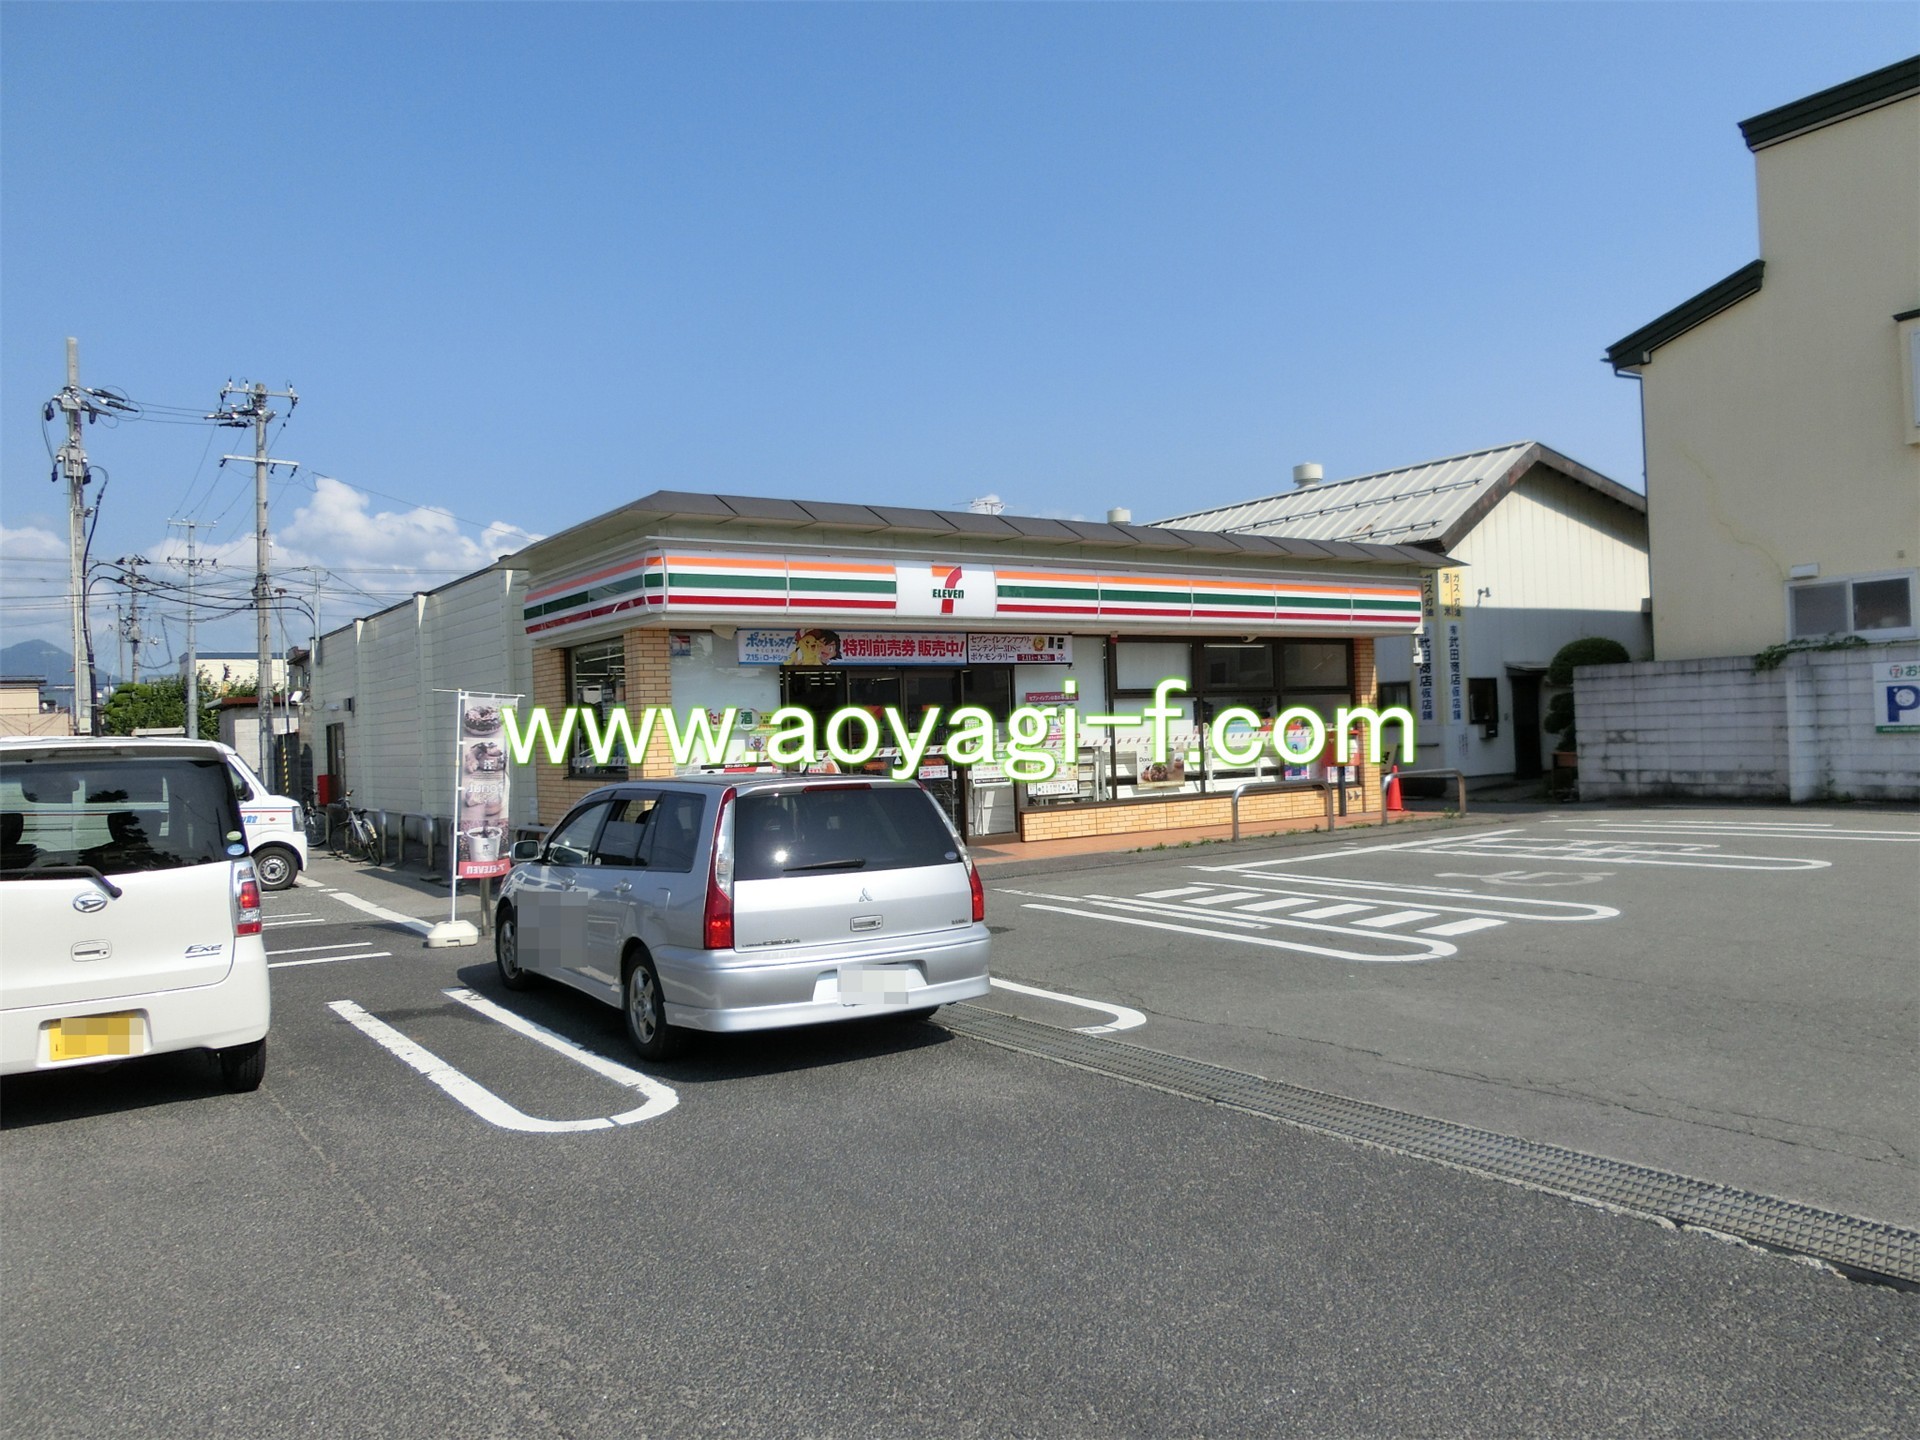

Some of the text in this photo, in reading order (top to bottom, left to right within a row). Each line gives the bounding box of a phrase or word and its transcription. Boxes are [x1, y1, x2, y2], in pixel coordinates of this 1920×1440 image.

[842, 638, 916, 658] 特別前売券
[971, 652, 1015, 661] ポケモンラリー
[1905, 665, 1920, 677] お
[1887, 685, 1920, 722] P
[740, 711, 753, 725] 酒
[184, 944, 223, 955] Exe
